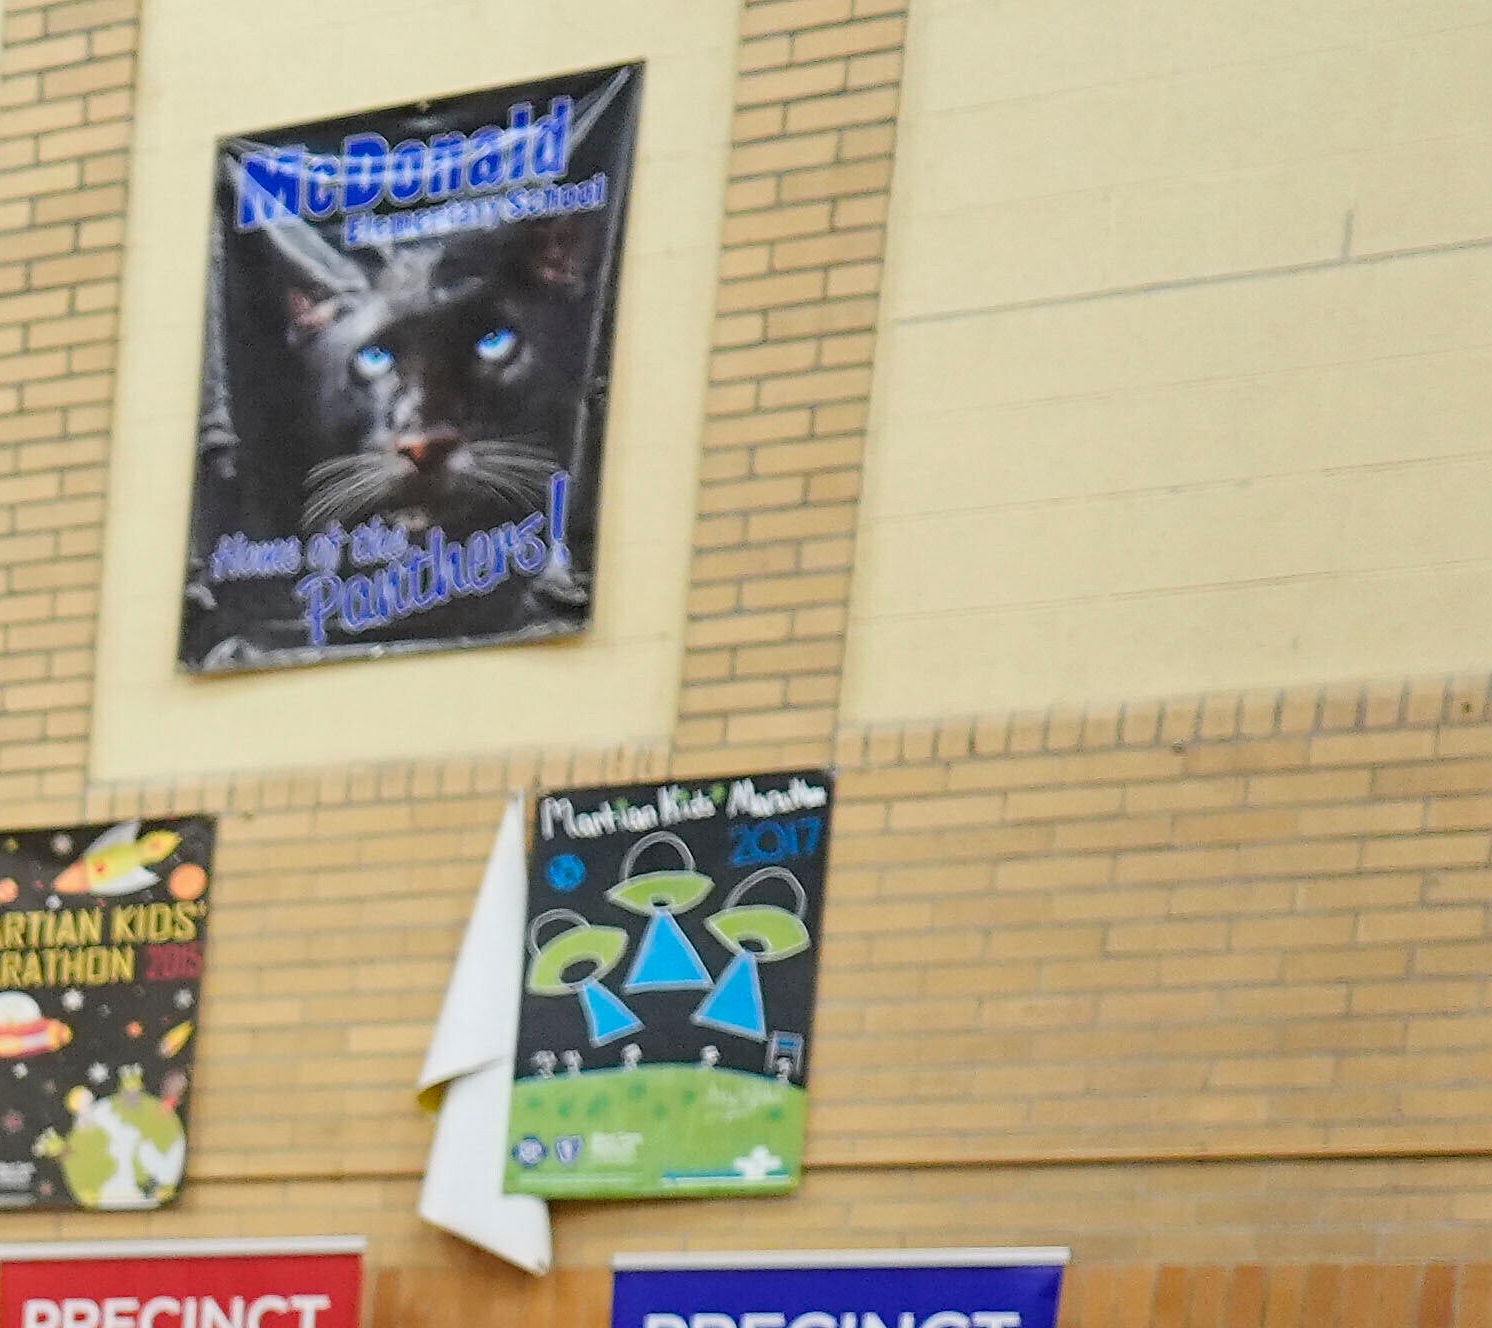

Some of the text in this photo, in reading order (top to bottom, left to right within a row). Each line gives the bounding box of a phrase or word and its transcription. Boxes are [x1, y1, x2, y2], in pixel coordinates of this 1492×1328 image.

[236, 94, 574, 230] McDonald
[500, 172, 606, 221] School
[210, 518, 410, 581] Home of the
[296, 471, 571, 648] Panthers!
[732, 816, 822, 866] 2017
